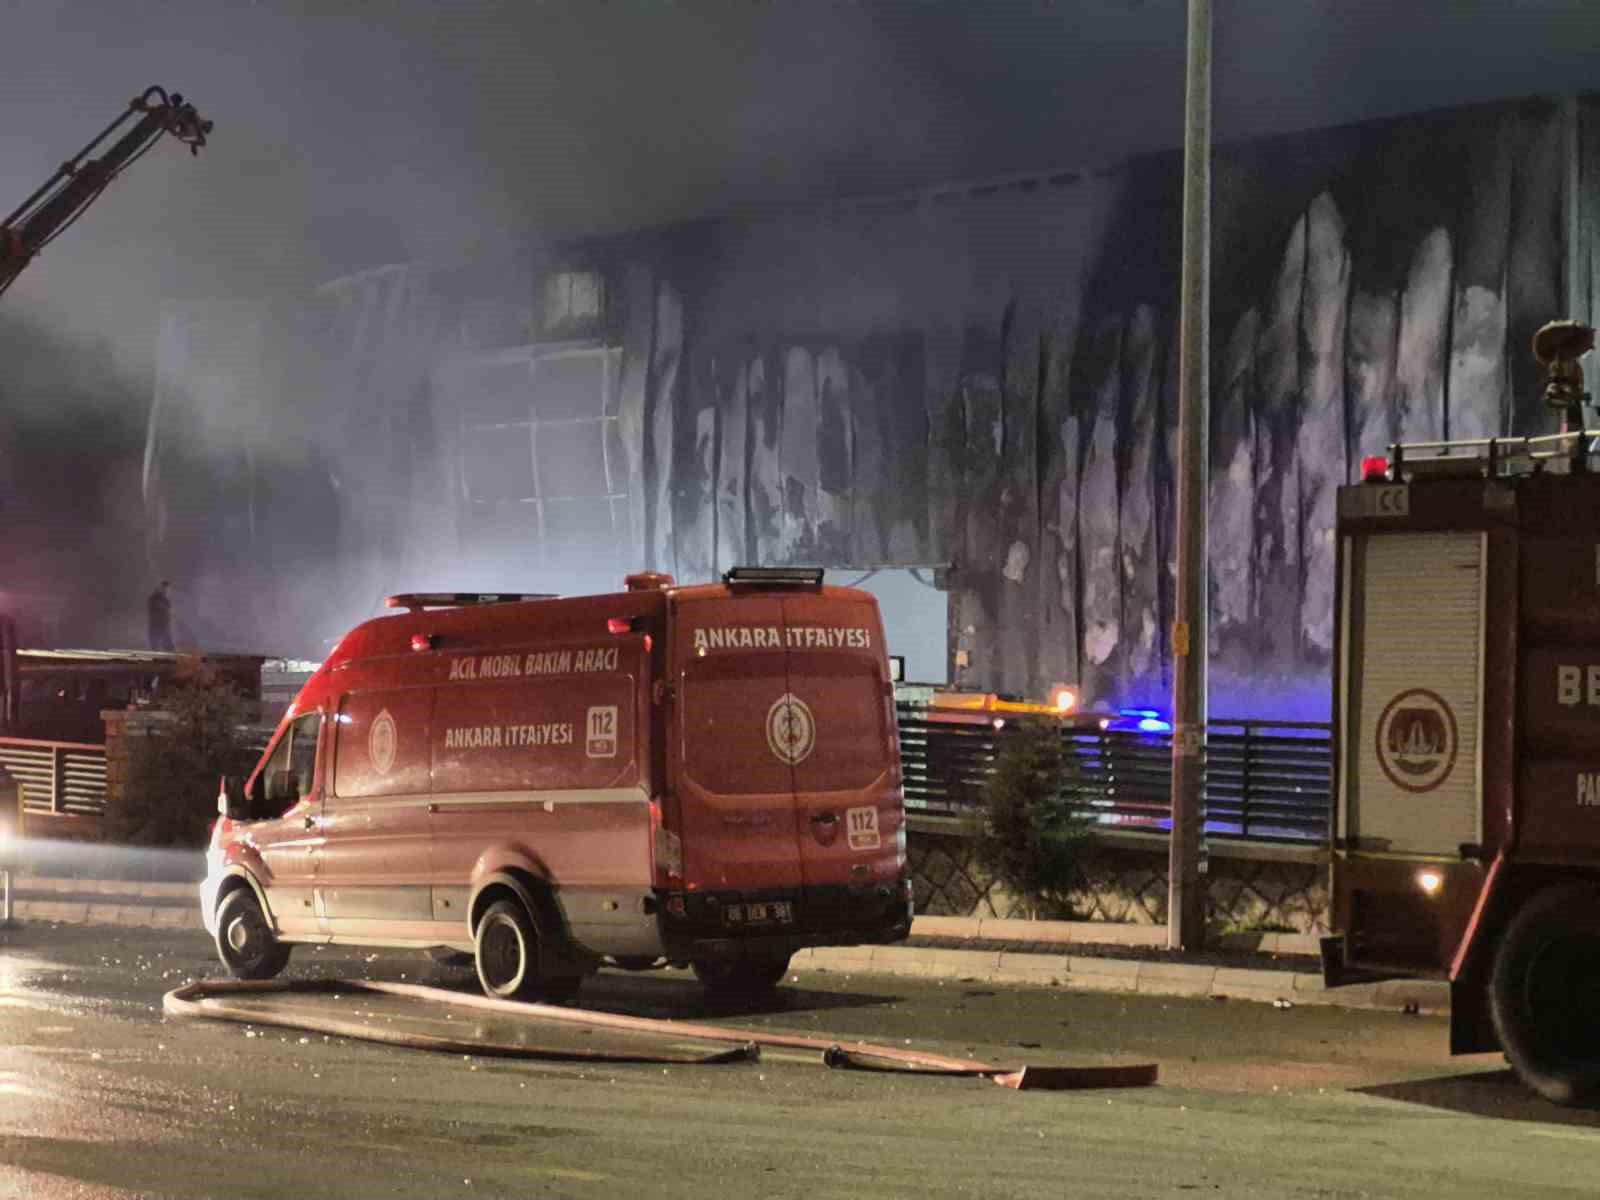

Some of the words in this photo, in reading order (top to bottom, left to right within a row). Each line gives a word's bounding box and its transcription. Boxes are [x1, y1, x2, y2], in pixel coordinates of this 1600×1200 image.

[694, 628, 780, 647] ANKARA
[525, 651, 571, 675] BAKIM
[575, 648, 619, 672] ARACI
[592, 712, 613, 735] 112
[445, 728, 501, 747] ANKARA
[851, 810, 874, 831] 112
